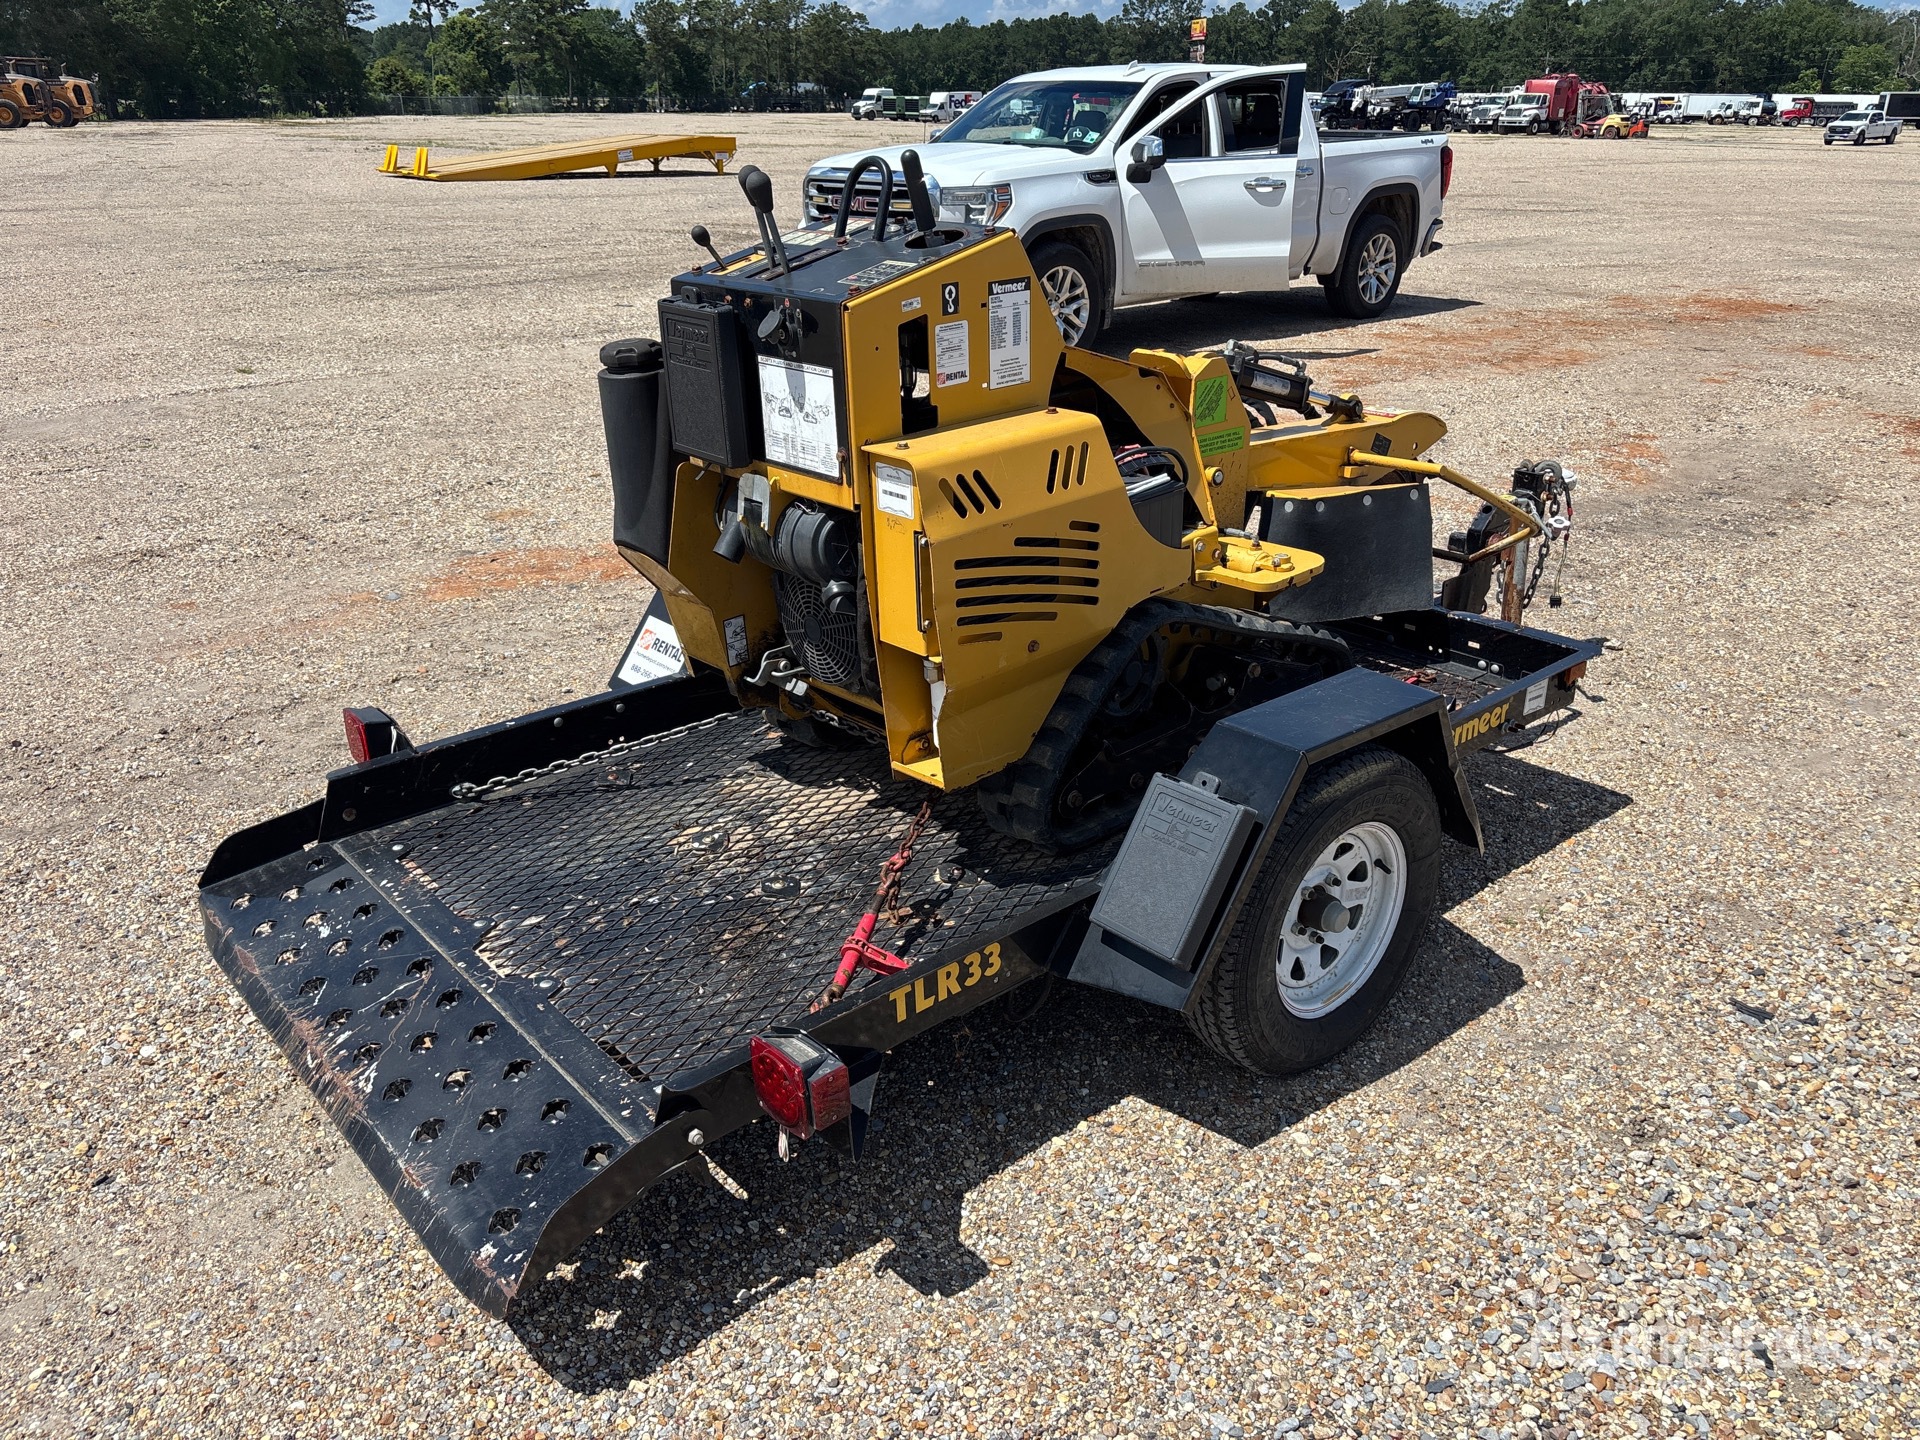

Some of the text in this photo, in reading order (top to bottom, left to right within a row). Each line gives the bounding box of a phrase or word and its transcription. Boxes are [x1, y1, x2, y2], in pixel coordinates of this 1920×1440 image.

[949, 94, 980, 109] FedE
[1072, 128, 1082, 138] rb
[831, 194, 880, 213] GMC
[992, 281, 1026, 294] Vermeer
[668, 320, 709, 344] Vermeer
[945, 370, 968, 382] RENTAL
[651, 637, 682, 663] RENTAL
[1452, 702, 1510, 747] rmeer
[1157, 796, 1219, 833] Vermeer
[888, 942, 1002, 1024] TLR33
